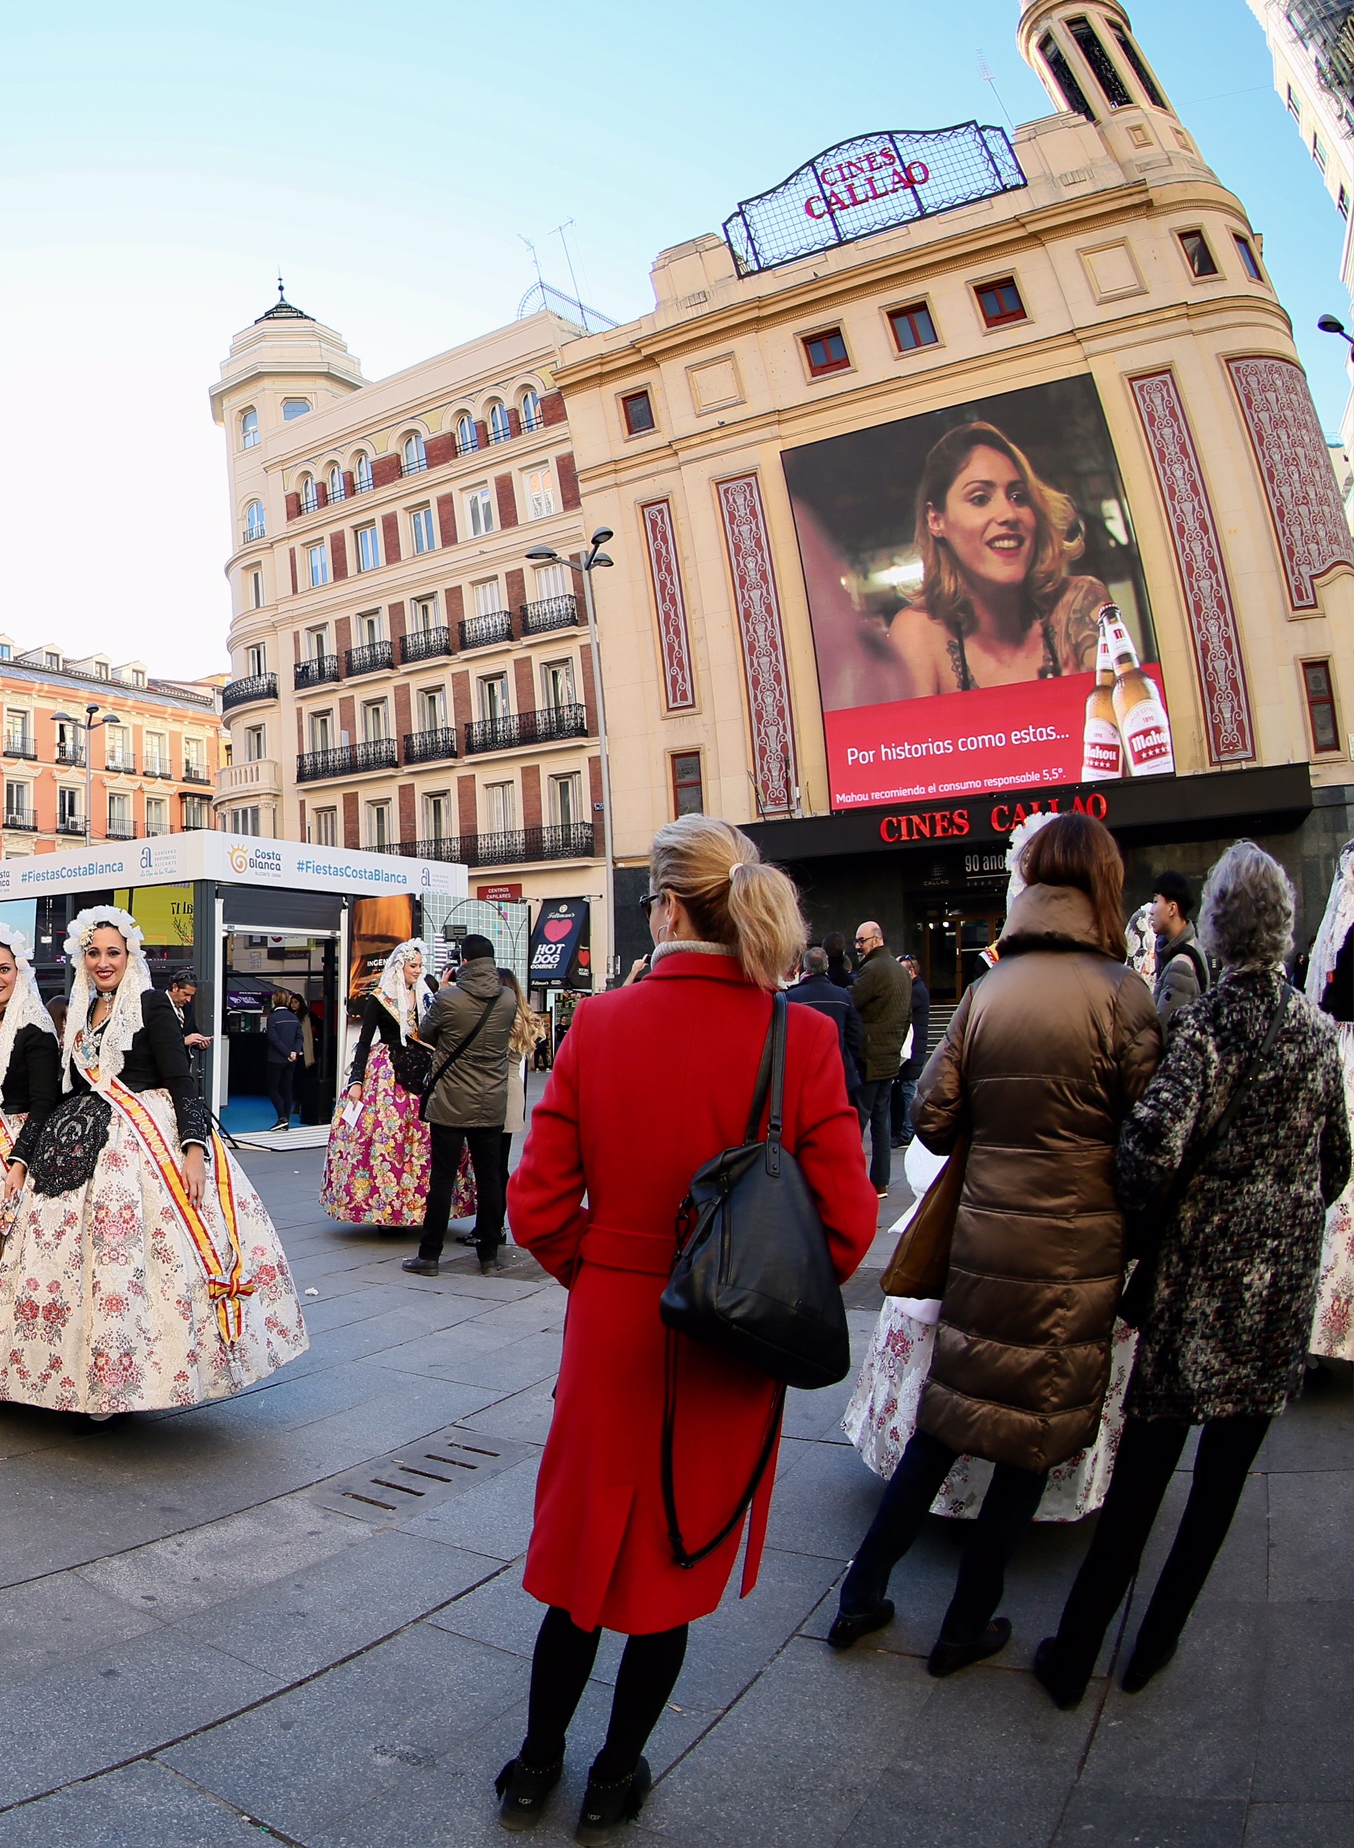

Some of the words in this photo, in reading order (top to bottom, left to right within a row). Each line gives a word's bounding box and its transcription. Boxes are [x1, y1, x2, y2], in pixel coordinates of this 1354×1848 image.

[820, 147, 896, 186] CINES
[804, 161, 930, 219] CALLAO
[847, 747, 875, 765] Por
[881, 738, 953, 761] historias
[957, 732, 1006, 752] como
[836, 792, 869, 803] Mahou
[871, 786, 925, 800] recomienda
[927, 783, 936, 794] el
[938, 780, 981, 793] consumo
[983, 771, 1040, 790] responsable
[879, 809, 970, 843] CINES
[249, 857, 282, 871] Blanca
[255, 848, 282, 861] Costa
[965, 854, 979, 872] 90
[21, 861, 124, 884] #FiestasCostaBlanca
[296, 859, 408, 885] #FiestasCostaBlanca
[532, 954, 560, 964] DOG
[536, 944, 565, 955] HOT
